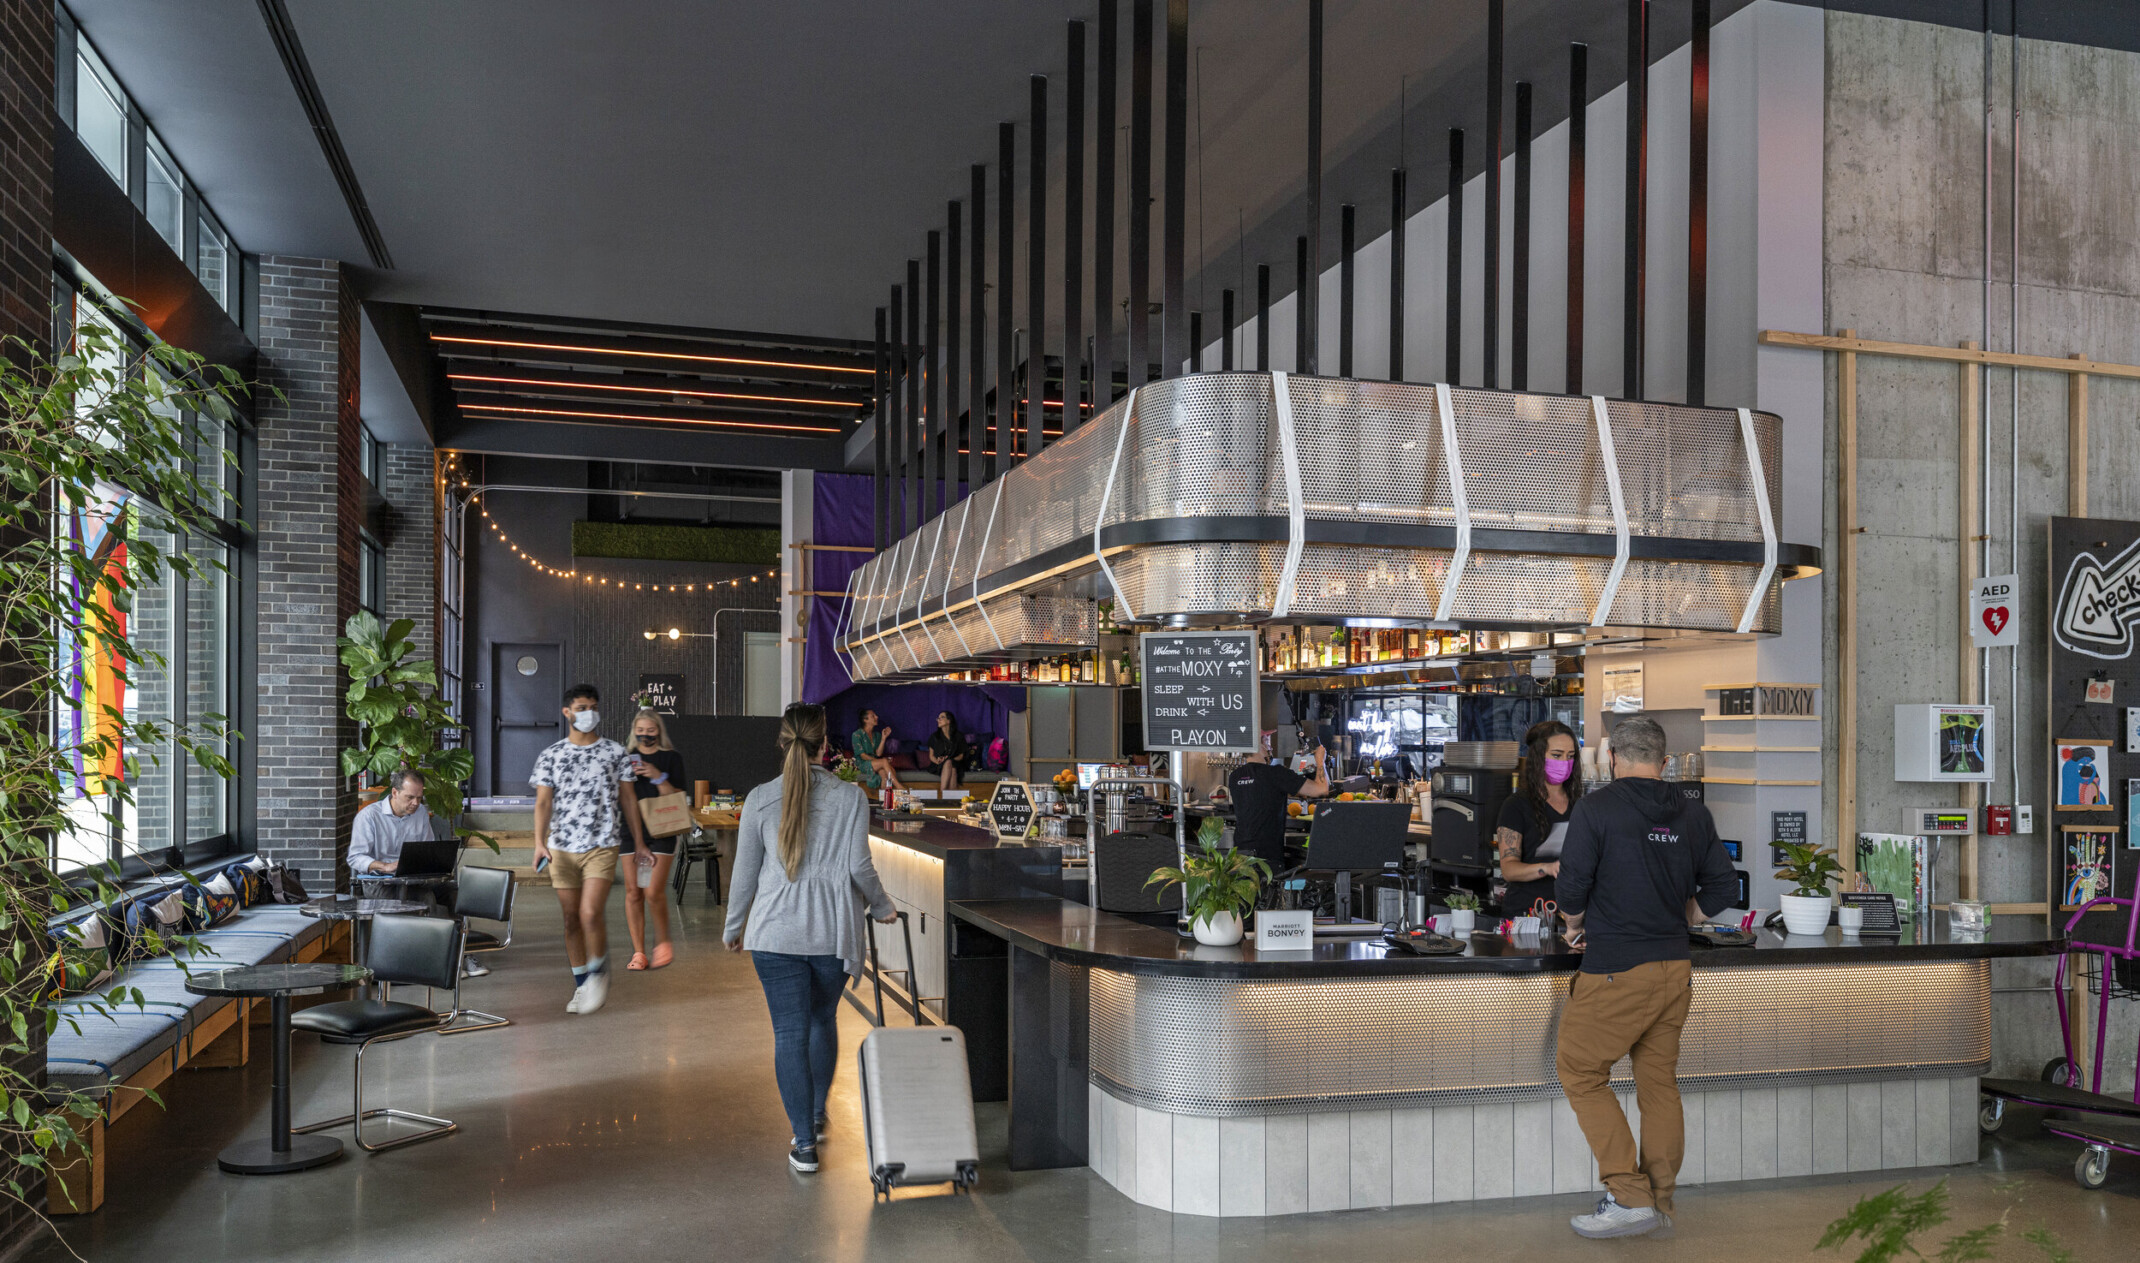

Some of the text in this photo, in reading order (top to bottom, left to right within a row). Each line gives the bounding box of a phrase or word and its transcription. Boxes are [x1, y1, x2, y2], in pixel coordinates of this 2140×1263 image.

[1981, 585, 2010, 597] AED
[1153, 643, 1243, 658] Welcome TO THE Party
[647, 683, 665, 694] EAT
[1154, 685, 1184, 694] SLEEP
[653, 695, 677, 707] PLAY
[1187, 694, 1243, 710] WITH US
[1721, 689, 1814, 714] THE MOXY
[1155, 708, 1188, 717] DRINK
[1648, 834, 1679, 843] CREW
